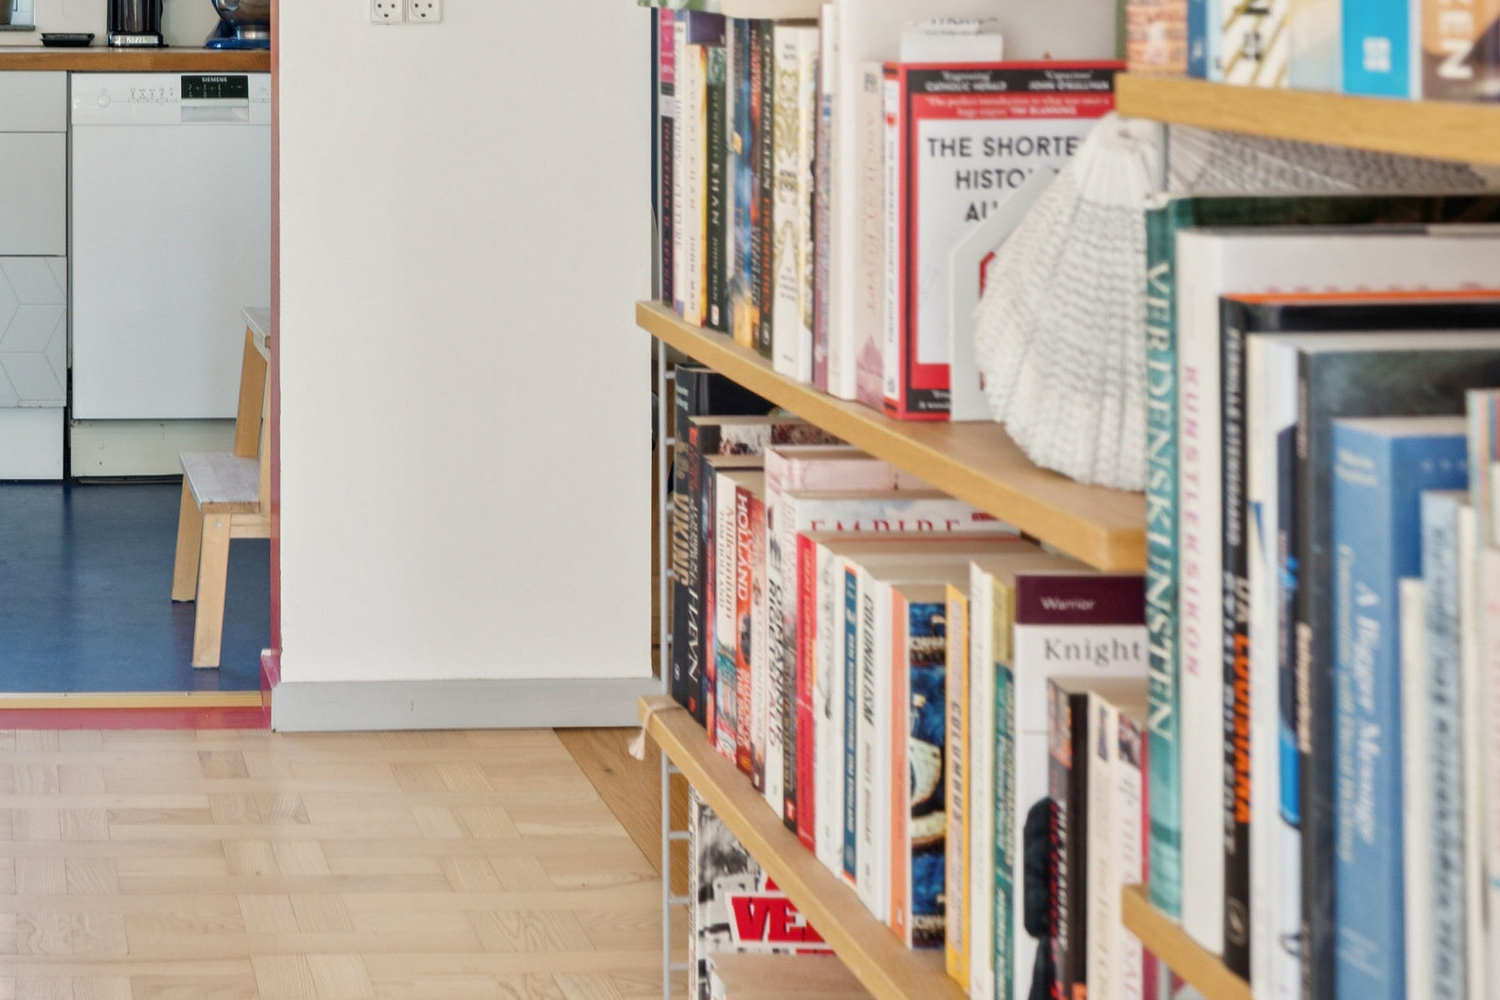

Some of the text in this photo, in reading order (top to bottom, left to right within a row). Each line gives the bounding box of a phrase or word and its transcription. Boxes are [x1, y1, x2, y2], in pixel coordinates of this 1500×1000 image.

[710, 161, 722, 226] KHAN
[927, 136, 1082, 158] THE SHORTE
[955, 168, 1061, 190] HISTO
[673, 491, 691, 587] VIKING
[725, 505, 734, 621] Millennium
[737, 492, 749, 602] HOLLAND
[688, 587, 700, 684] HÆVN
[1040, 595, 1096, 610] Warrior
[1355, 581, 1381, 607] A
[863, 593, 875, 727] COLONIALISM
[1043, 637, 1142, 667] Knight
[1353, 616, 1381, 713] Bigger
[952, 700, 963, 824] COLUMBUS
[1233, 632, 1252, 824] LOUISIANA
